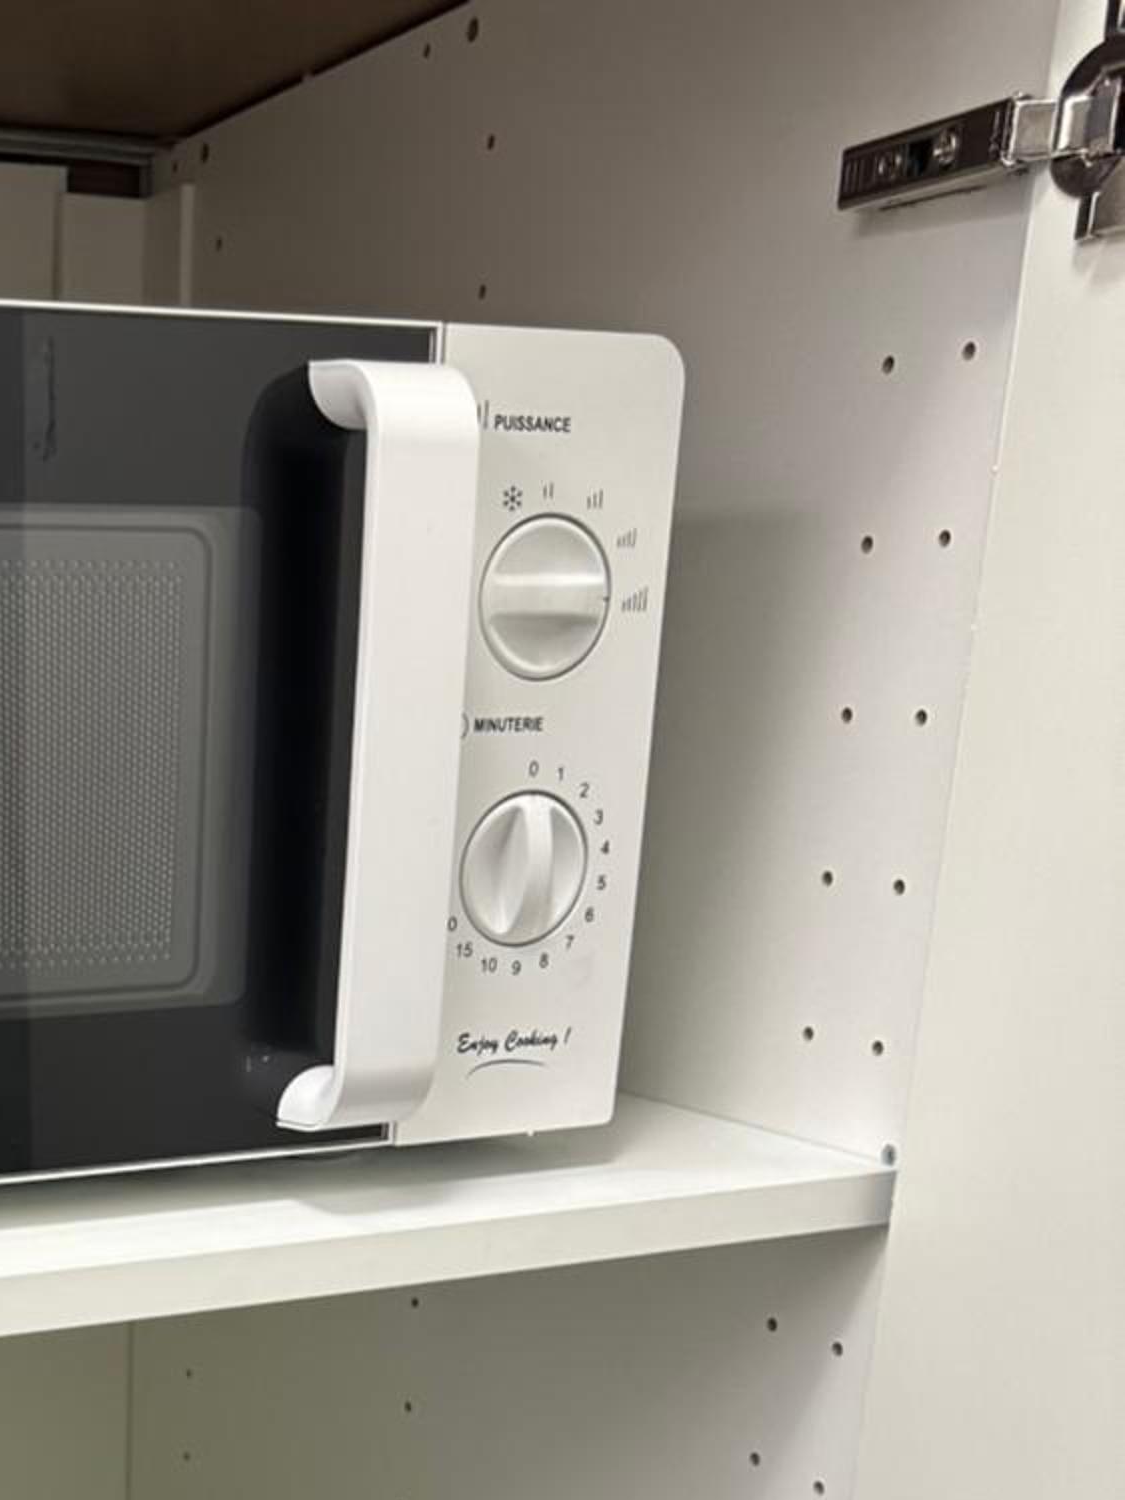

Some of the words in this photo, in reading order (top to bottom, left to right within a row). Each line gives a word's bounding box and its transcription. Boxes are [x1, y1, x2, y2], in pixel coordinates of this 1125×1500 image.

[493, 413, 571, 433] PUISSANCE
[474, 716, 544, 732] MINUTERIE
[528, 760, 539, 777] 0
[557, 767, 564, 780] 1
[579, 782, 590, 798] 2
[593, 810, 604, 825] 3
[600, 841, 610, 855] 4
[596, 875, 606, 891] 5
[584, 907, 594, 923] 6
[447, 915, 458, 932] 0
[456, 941, 474, 958] 15
[565, 935, 575, 949] 7
[480, 957, 498, 974] 10
[511, 959, 522, 977] 9
[538, 953, 549, 969] 8
